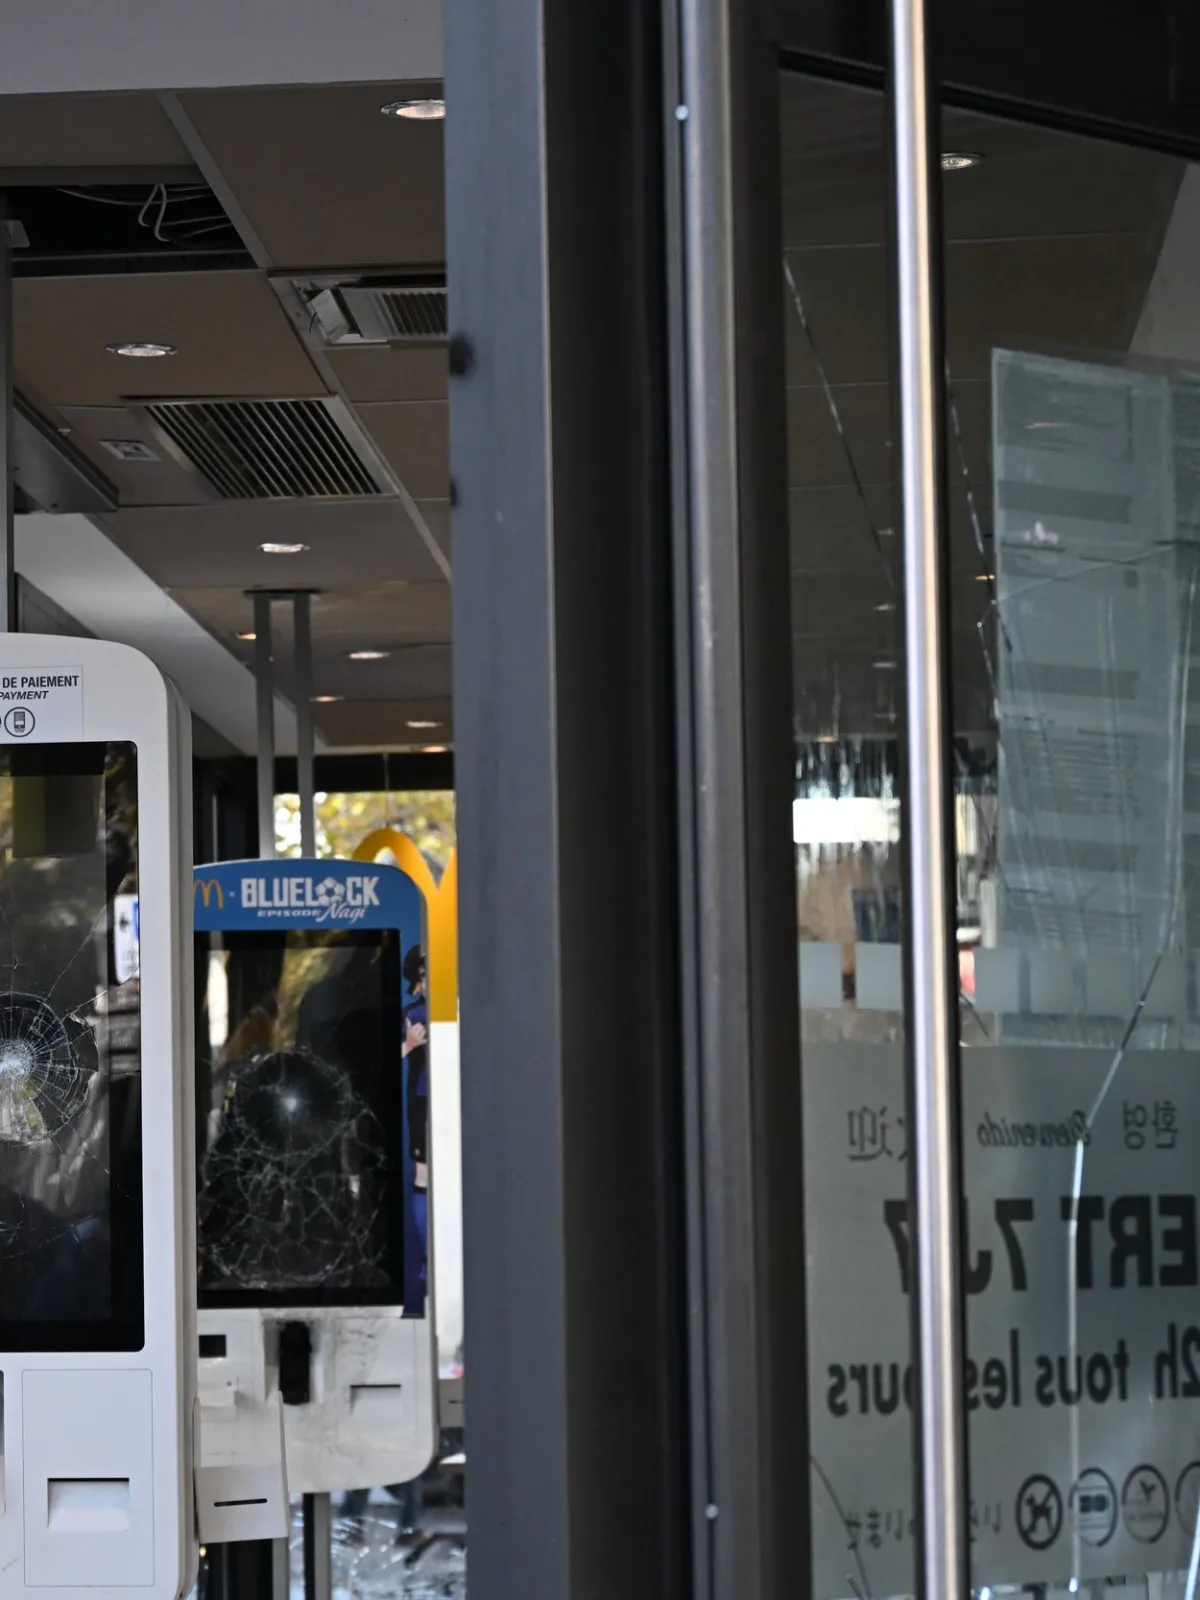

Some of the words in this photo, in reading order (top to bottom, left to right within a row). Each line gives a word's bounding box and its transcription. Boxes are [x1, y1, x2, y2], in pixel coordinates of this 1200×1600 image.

[2, 676, 18, 689] DE
[21, 675, 80, 688] PAIEMENT
[256, 908, 322, 918] EPISODE
[314, 901, 367, 924] Nagi
